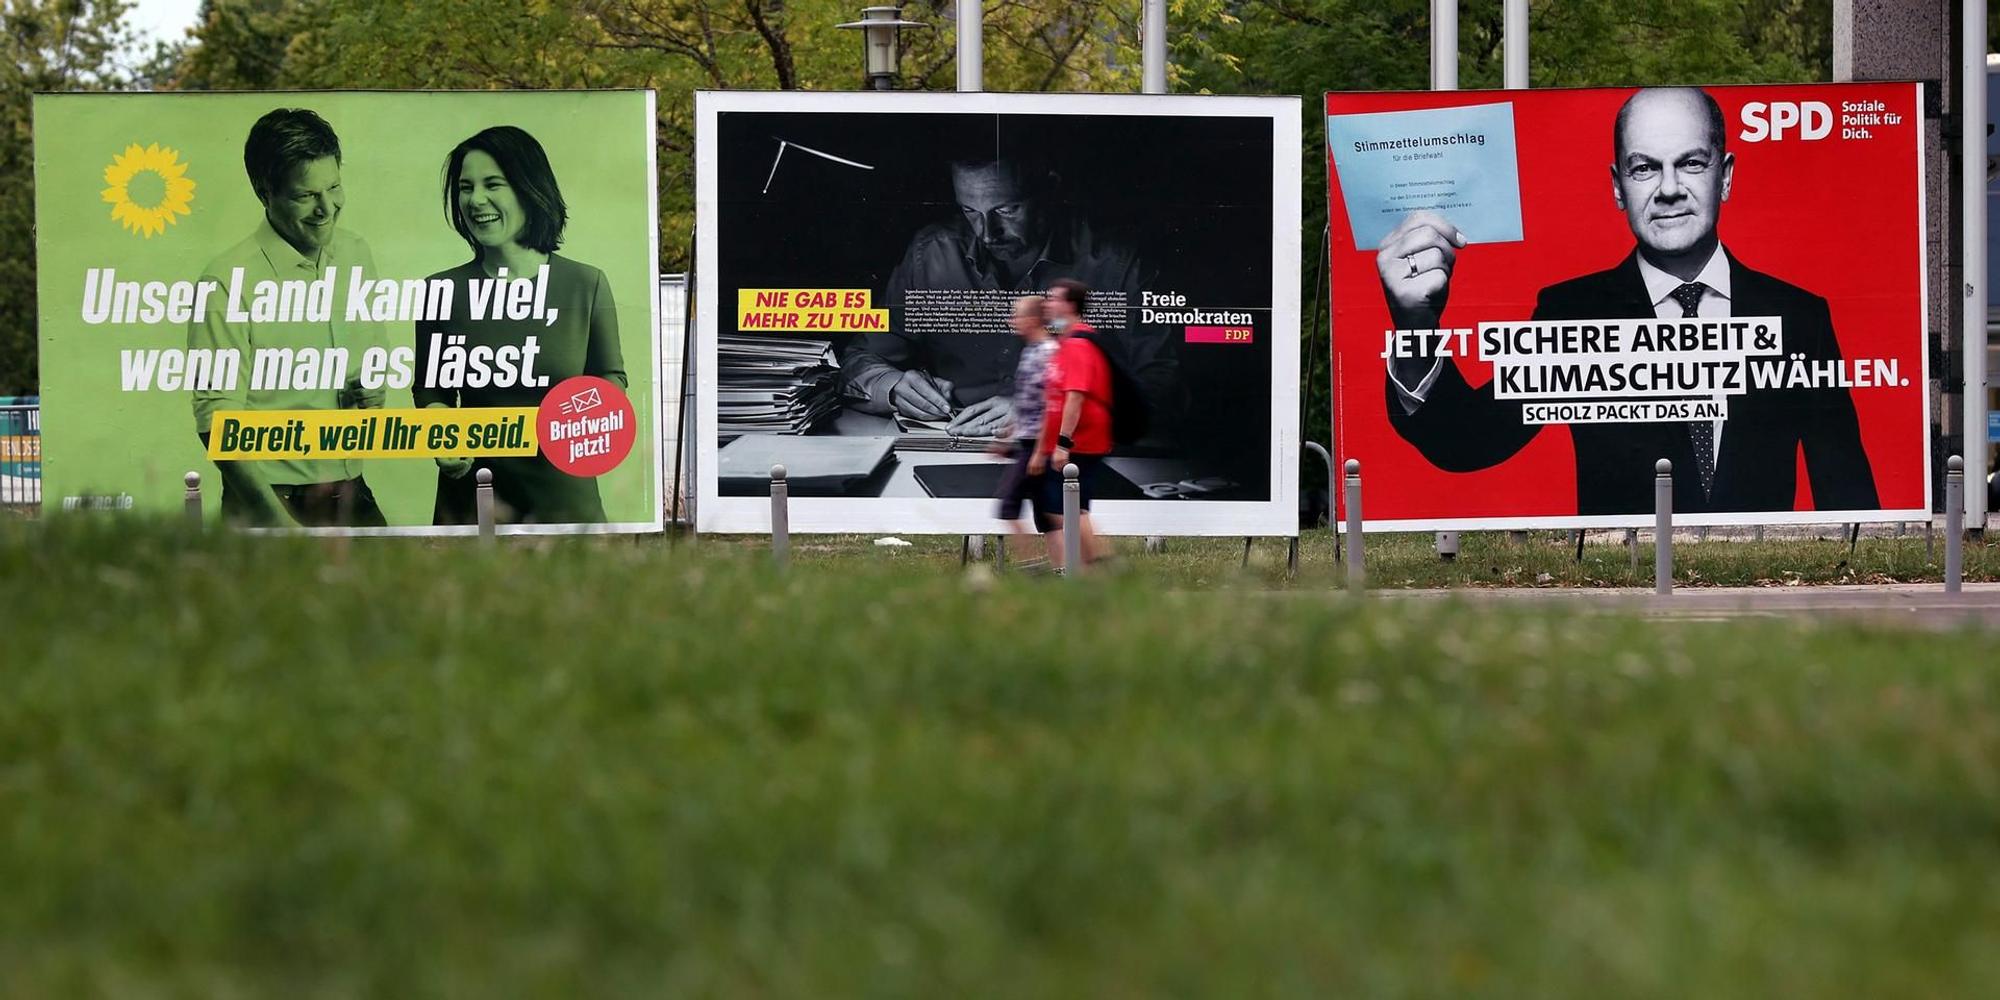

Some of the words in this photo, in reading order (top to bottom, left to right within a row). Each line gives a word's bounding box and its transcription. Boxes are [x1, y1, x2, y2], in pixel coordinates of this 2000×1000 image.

[1842, 100, 1885, 112] Soziale
[1740, 102, 1833, 142] SPD
[1842, 113, 1881, 126] Politik
[1883, 111, 1902, 126] für
[1354, 133, 1485, 153] Stimmzettelumschlag
[1842, 127, 1873, 140] Dich.
[82, 268, 217, 325] Unser
[226, 266, 336, 324] Land
[345, 265, 455, 321] kann
[468, 264, 559, 327] viel,
[756, 292, 788, 308] NIE
[795, 292, 837, 309] GAB
[843, 292, 865, 308] ES
[1142, 291, 1187, 307] Freie
[742, 312, 800, 329] MEHR
[805, 312, 834, 329] ZU
[840, 313, 886, 330] TUN.
[1142, 308, 1253, 325] Demokraten
[1225, 329, 1250, 340] FDP
[1380, 328, 1473, 359] JETZT
[1483, 325, 1621, 355] SICHERE
[1630, 322, 1749, 352] ARBEIT
[1753, 324, 1777, 350] &
[120, 347, 241, 392] wenn
[250, 346, 350, 391] man
[360, 346, 416, 390] es
[425, 333, 550, 389] lässt.
[1500, 361, 1741, 393] KLIMASCHUTZ
[1750, 352, 1909, 389] WÄHLEN.
[1526, 405, 1592, 422] SCHOLZ
[1596, 404, 1651, 420] PACKT
[1655, 403, 1690, 419] DAS
[1694, 402, 1726, 418] AN.
[220, 418, 311, 456] Bereit,
[319, 416, 377, 451] weil
[381, 416, 423, 451] Ihr
[427, 423, 460, 450] es
[465, 415, 530, 450] seid.
[550, 410, 624, 441] Briefwahl
[560, 430, 619, 463] jetzt!
